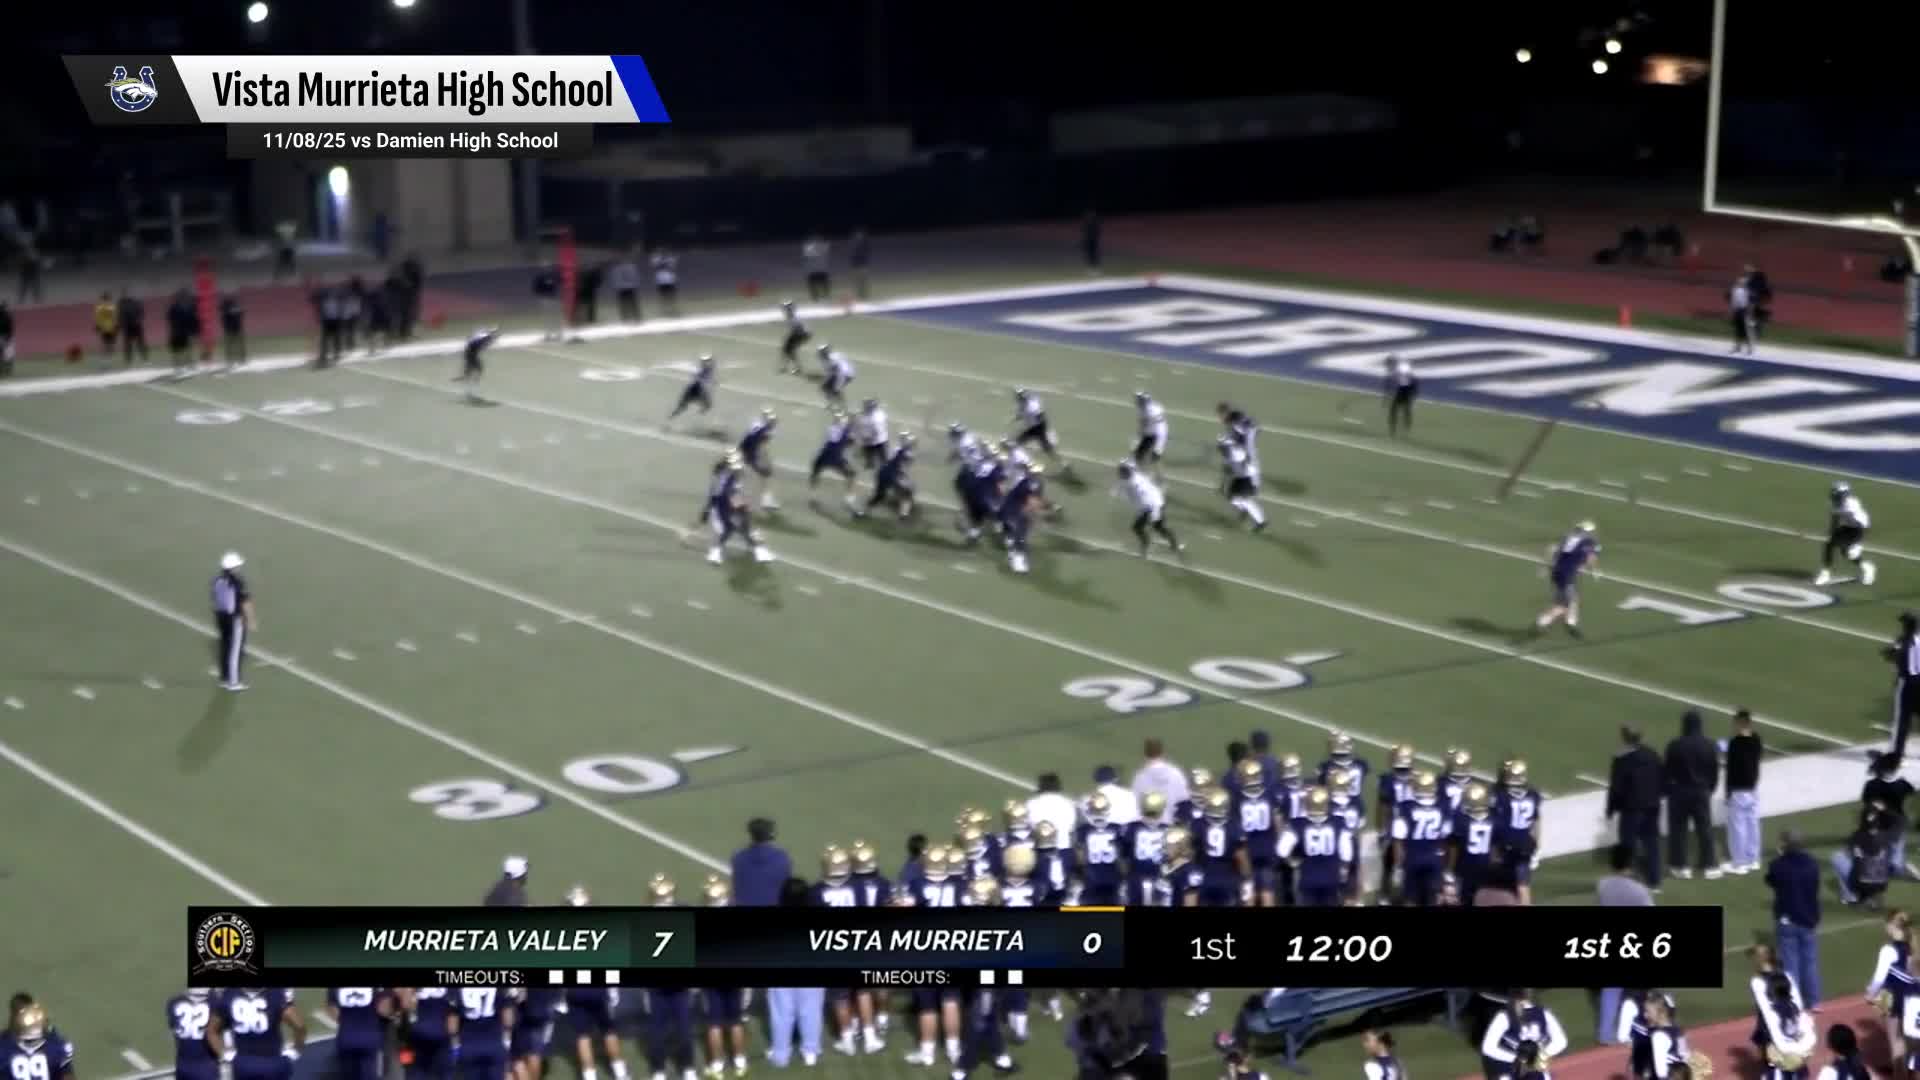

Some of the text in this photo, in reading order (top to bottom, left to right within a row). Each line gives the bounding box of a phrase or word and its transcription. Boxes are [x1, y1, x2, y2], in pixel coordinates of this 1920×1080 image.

[1062, 656, 1311, 713] 20
[408, 754, 683, 822] 30
[1240, 800, 1271, 832] 80
[1411, 809, 1442, 840] 72
[1510, 801, 1535, 830] 12
[1207, 825, 1226, 857] 9
[231, 998, 269, 1034] 96
[460, 987, 497, 1018] 97
[174, 1002, 209, 1039] 32
[10, 1054, 48, 1080] 99
